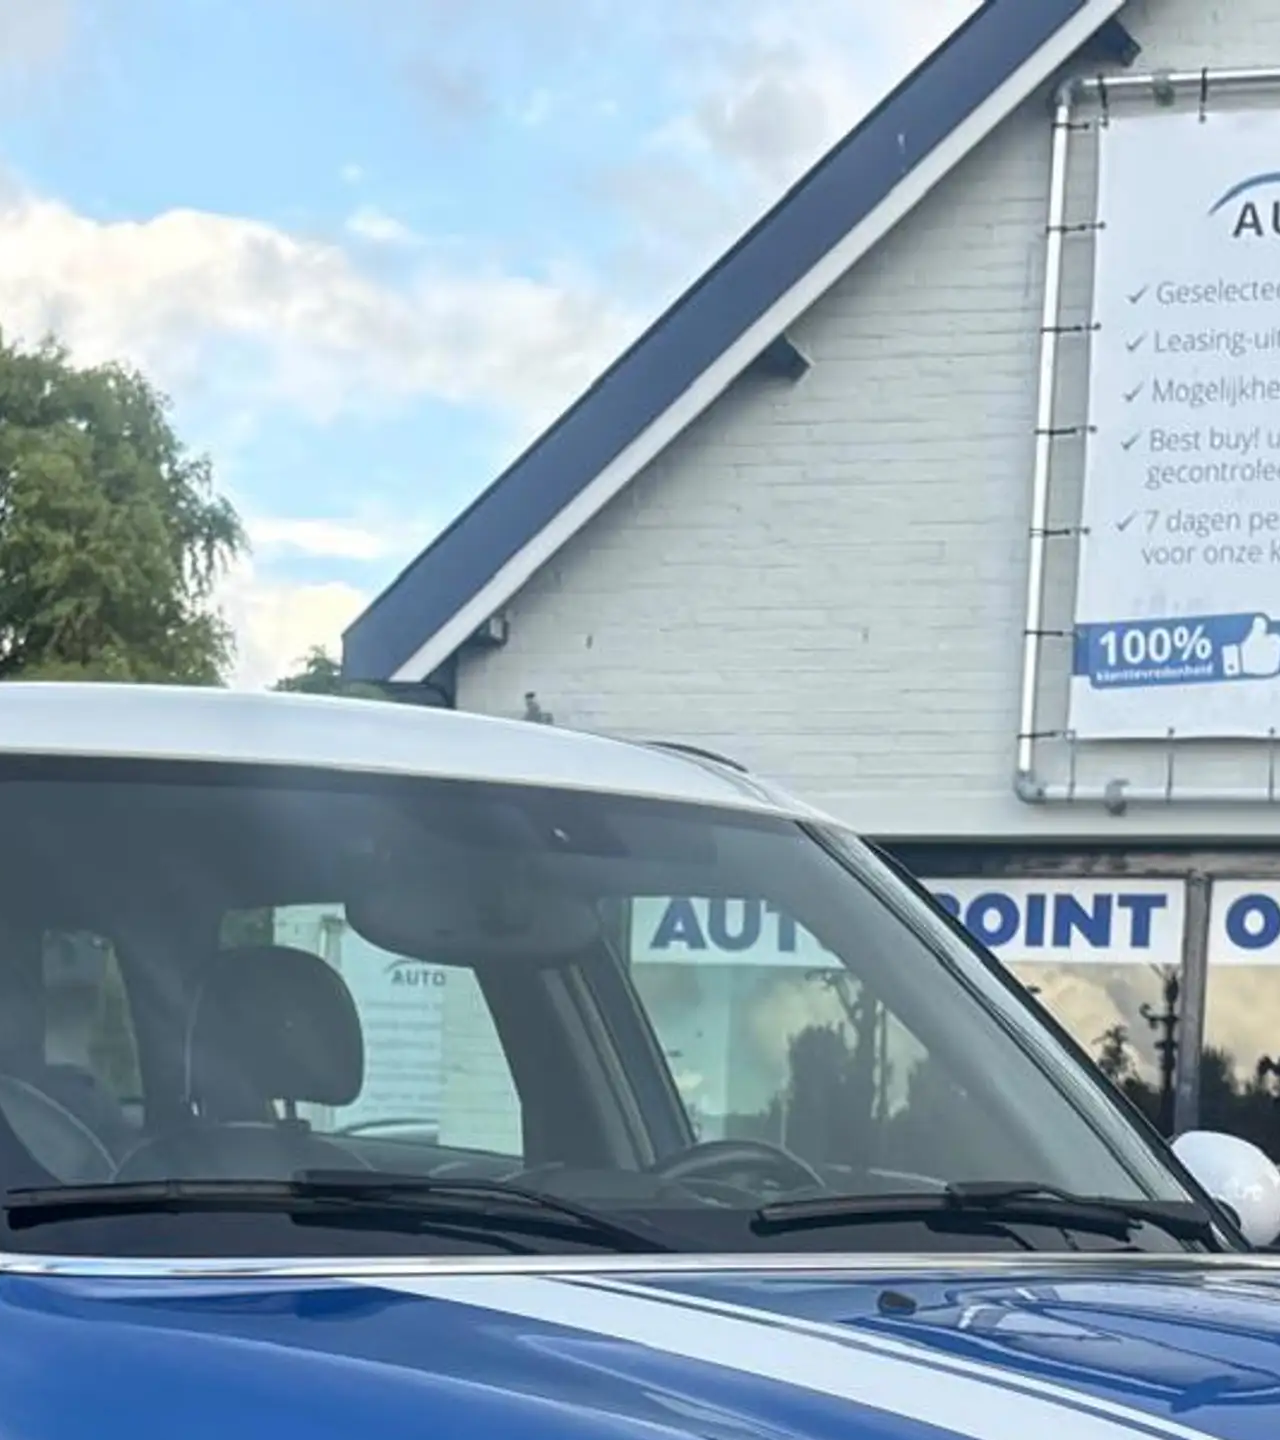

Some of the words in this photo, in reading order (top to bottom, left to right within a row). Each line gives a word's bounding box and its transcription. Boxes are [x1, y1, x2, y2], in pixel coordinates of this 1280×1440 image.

[1150, 428, 1202, 451] Best
[1210, 425, 1260, 455] buy!
[1144, 510, 1161, 533] 7
[1165, 509, 1241, 538] dagen
[1141, 545, 1196, 566] voor
[1203, 544, 1264, 565] onze
[1099, 625, 1213, 667] 100%
[649, 898, 802, 953] AUT
